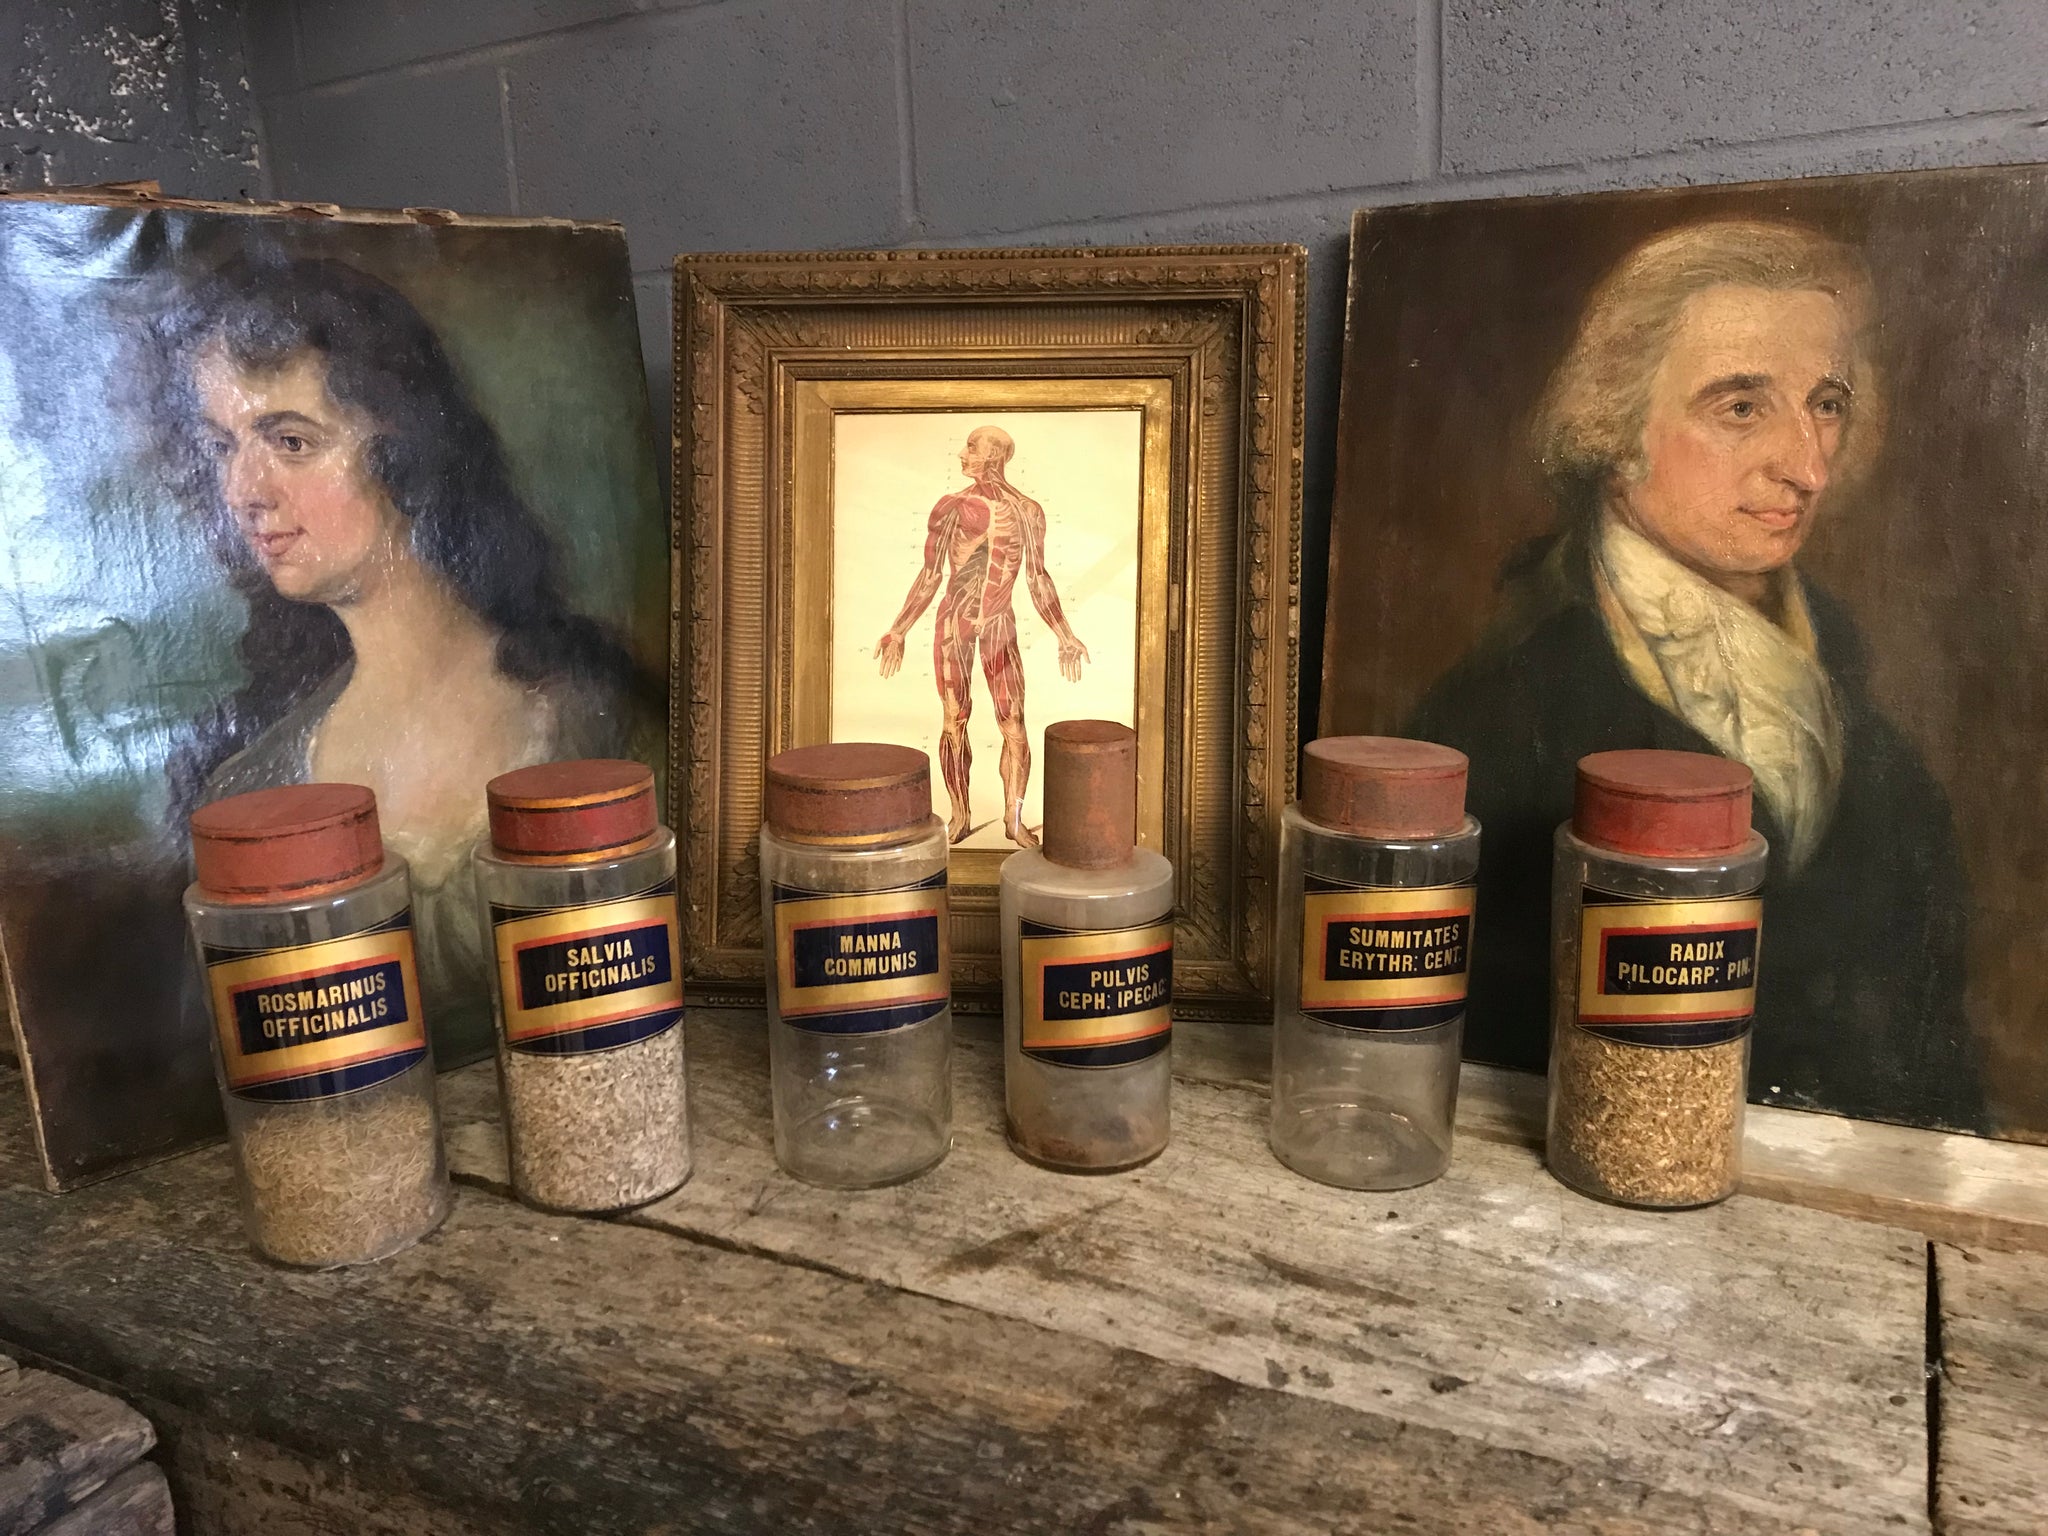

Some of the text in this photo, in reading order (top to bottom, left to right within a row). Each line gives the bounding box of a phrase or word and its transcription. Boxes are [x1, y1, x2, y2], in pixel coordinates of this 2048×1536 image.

[840, 931, 902, 953] MANNA
[1349, 923, 1460, 949] SUMMITATES
[567, 938, 634, 967] SALVIA
[824, 950, 917, 977] COMMUNIS
[1339, 948, 1418, 972] ERYTHR:
[1670, 940, 1725, 962] RADIX
[545, 955, 656, 992] OFFICINALIS
[1090, 963, 1150, 988] PULVIS
[1618, 961, 1720, 985] PILOCARP:
[257, 971, 386, 1014] ROSMARINUS
[1059, 991, 1111, 1010] CEPH:
[262, 997, 388, 1039] OFFICINALIS
